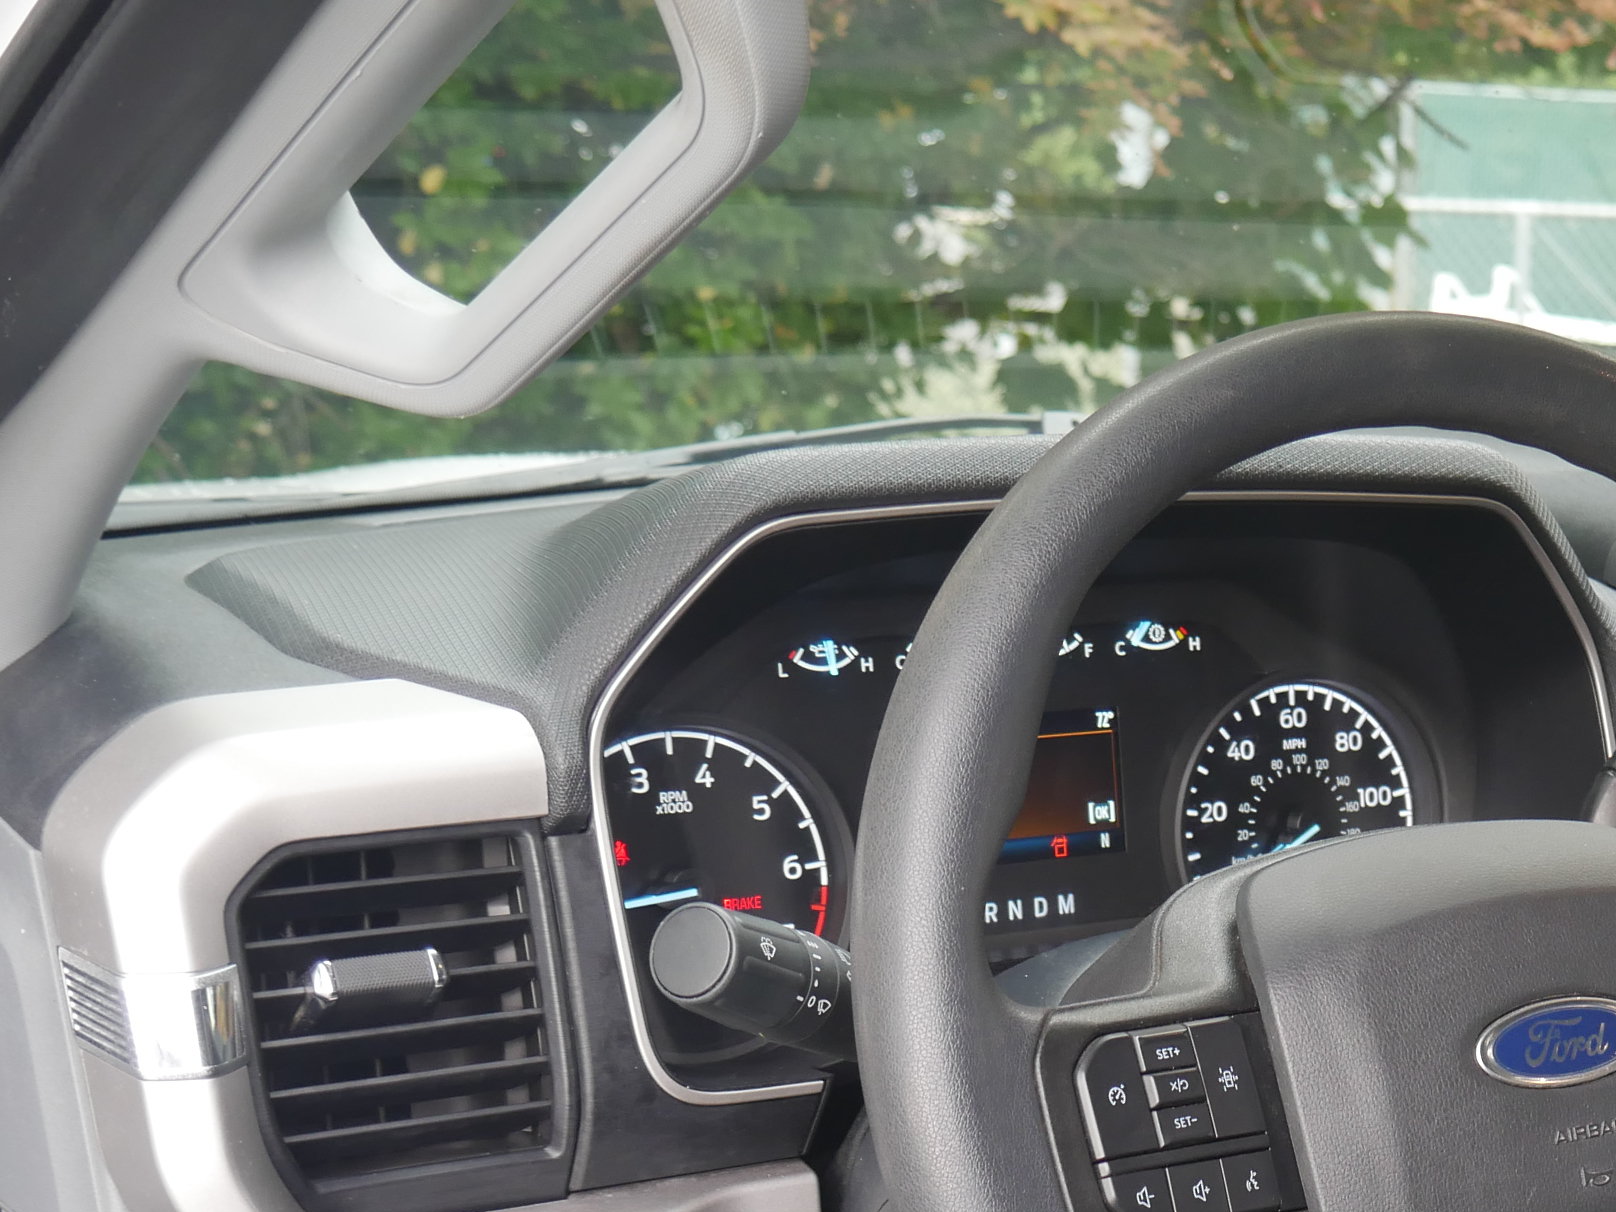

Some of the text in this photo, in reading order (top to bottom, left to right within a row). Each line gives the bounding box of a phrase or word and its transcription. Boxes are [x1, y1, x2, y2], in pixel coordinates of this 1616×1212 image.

[1083, 643, 1094, 658] F
[1115, 641, 1126, 656] C
[1188, 636, 1201, 652] H
[777, 662, 789, 678] L
[860, 657, 874, 672] H
[1279, 707, 1307, 729] 60
[1282, 738, 1306, 751] MPH
[1335, 731, 1362, 752] 80
[1226, 739, 1255, 761] 40
[1271, 759, 1283, 771] 80
[1292, 754, 1307, 765] 100
[1315, 758, 1329, 770] 120
[630, 768, 650, 794] 3
[694, 763, 715, 788] 4
[1250, 775, 1263, 787] 60
[1335, 775, 1350, 787] 140
[659, 790, 688, 803] RPM
[1357, 786, 1393, 809] 100
[655, 801, 693, 815] x1000
[752, 795, 771, 821] 5
[1201, 801, 1228, 823] 20
[1238, 803, 1250, 814] 40
[1100, 832, 1111, 848] N
[1237, 830, 1249, 841] 20
[782, 854, 803, 880] 6
[723, 896, 763, 911] BRAKE
[984, 893, 1076, 923] R N D M
[1523, 1016, 1610, 1069] Ford
